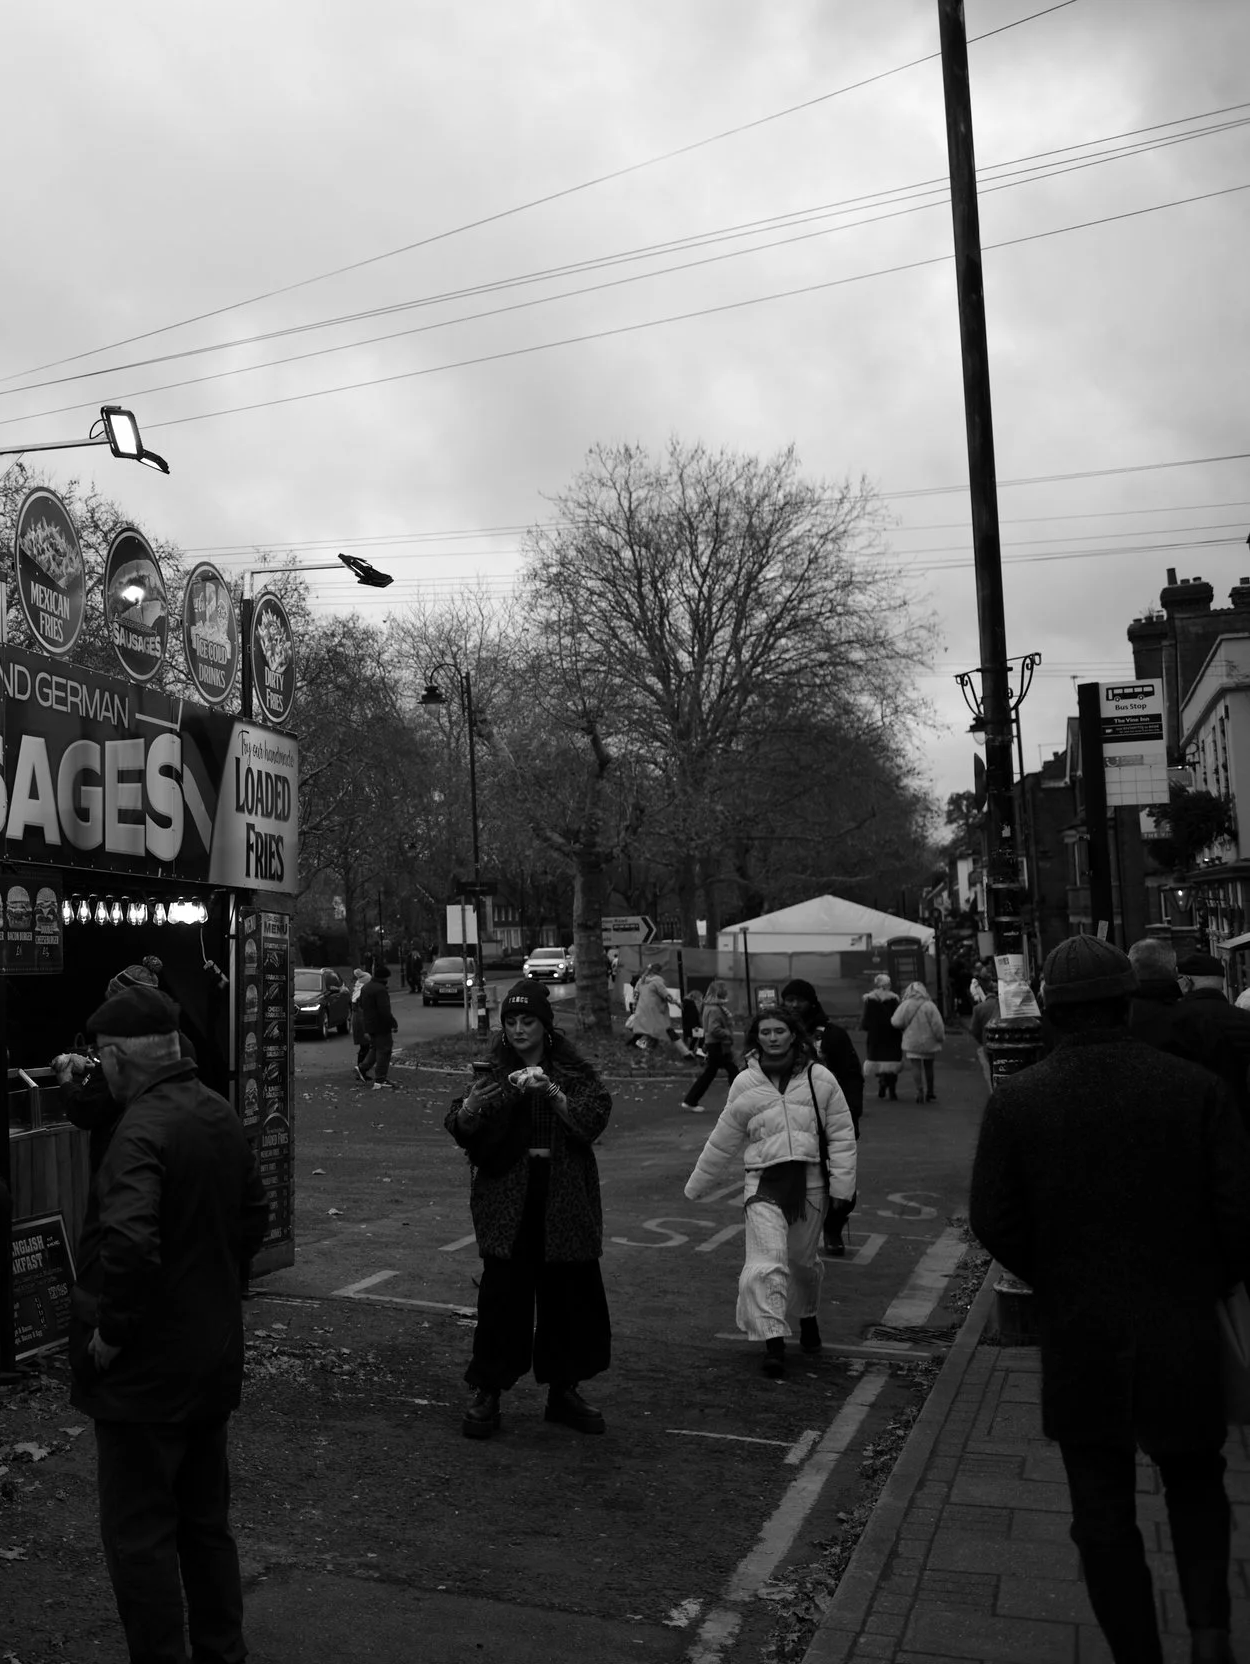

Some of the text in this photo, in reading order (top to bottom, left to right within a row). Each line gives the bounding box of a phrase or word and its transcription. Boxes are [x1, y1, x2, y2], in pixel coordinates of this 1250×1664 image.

[30, 580, 71, 620] MEXICAN
[39, 611, 64, 643] FRIES
[112, 621, 162, 658] SAUSAGES
[196, 634, 227, 665] ICE COLD
[198, 663, 226, 689] DRINKS
[264, 666, 285, 692] DIRTY
[35, 671, 130, 730] GERMAN
[266, 689, 284, 712] FRIES
[237, 729, 294, 768] Try our handmade
[235, 756, 291, 823] LOADED
[245, 822, 285, 883] FRIES
[263, 921, 288, 935] MENU
[12, 1234, 45, 1258] NGLISH
